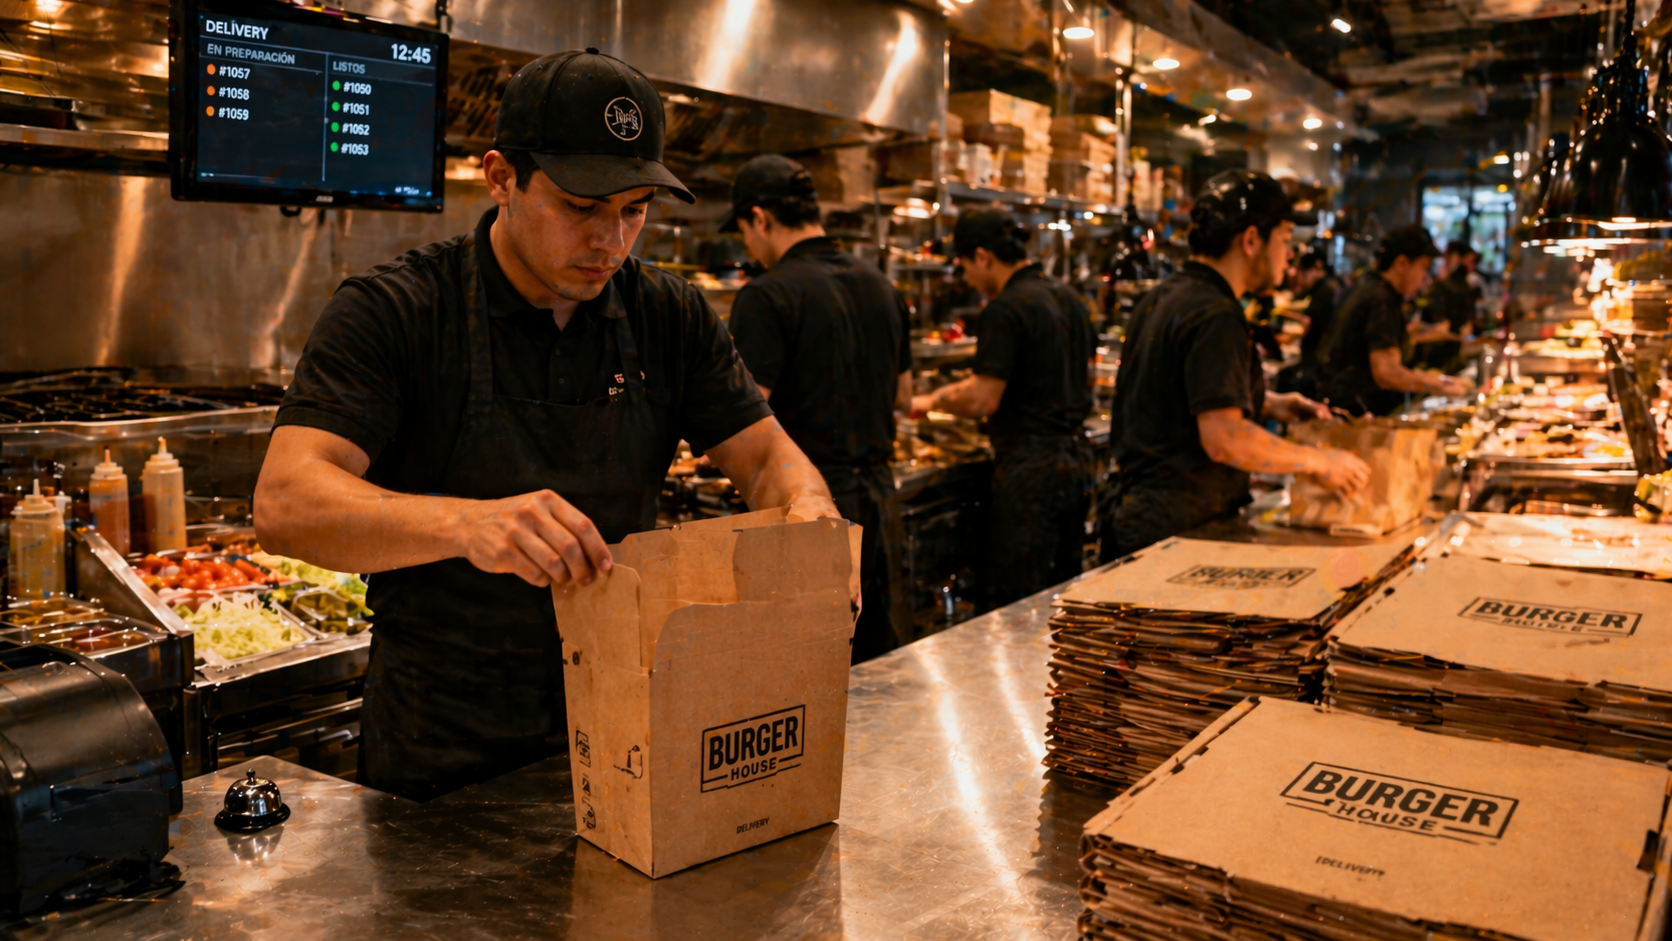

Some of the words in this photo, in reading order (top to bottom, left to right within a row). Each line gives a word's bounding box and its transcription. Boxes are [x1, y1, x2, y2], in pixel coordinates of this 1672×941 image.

[207, 43, 222, 56] EN
[225, 46, 295, 65] PREPARACIÓN
[391, 43, 431, 64] 12:45
[219, 66, 250, 79] #1057
[332, 61, 366, 74] LISTOS
[218, 86, 250, 100] #1058
[343, 82, 371, 95] #1050
[218, 107, 249, 120] #1059
[342, 102, 370, 116] #1051
[341, 123, 370, 136] #1052
[340, 143, 369, 156] #1053
[1474, 601, 1628, 629] BURGER
[708, 715, 799, 771] BURGER
[730, 756, 777, 781] HOUSE
[1302, 769, 1499, 827] BURGER
